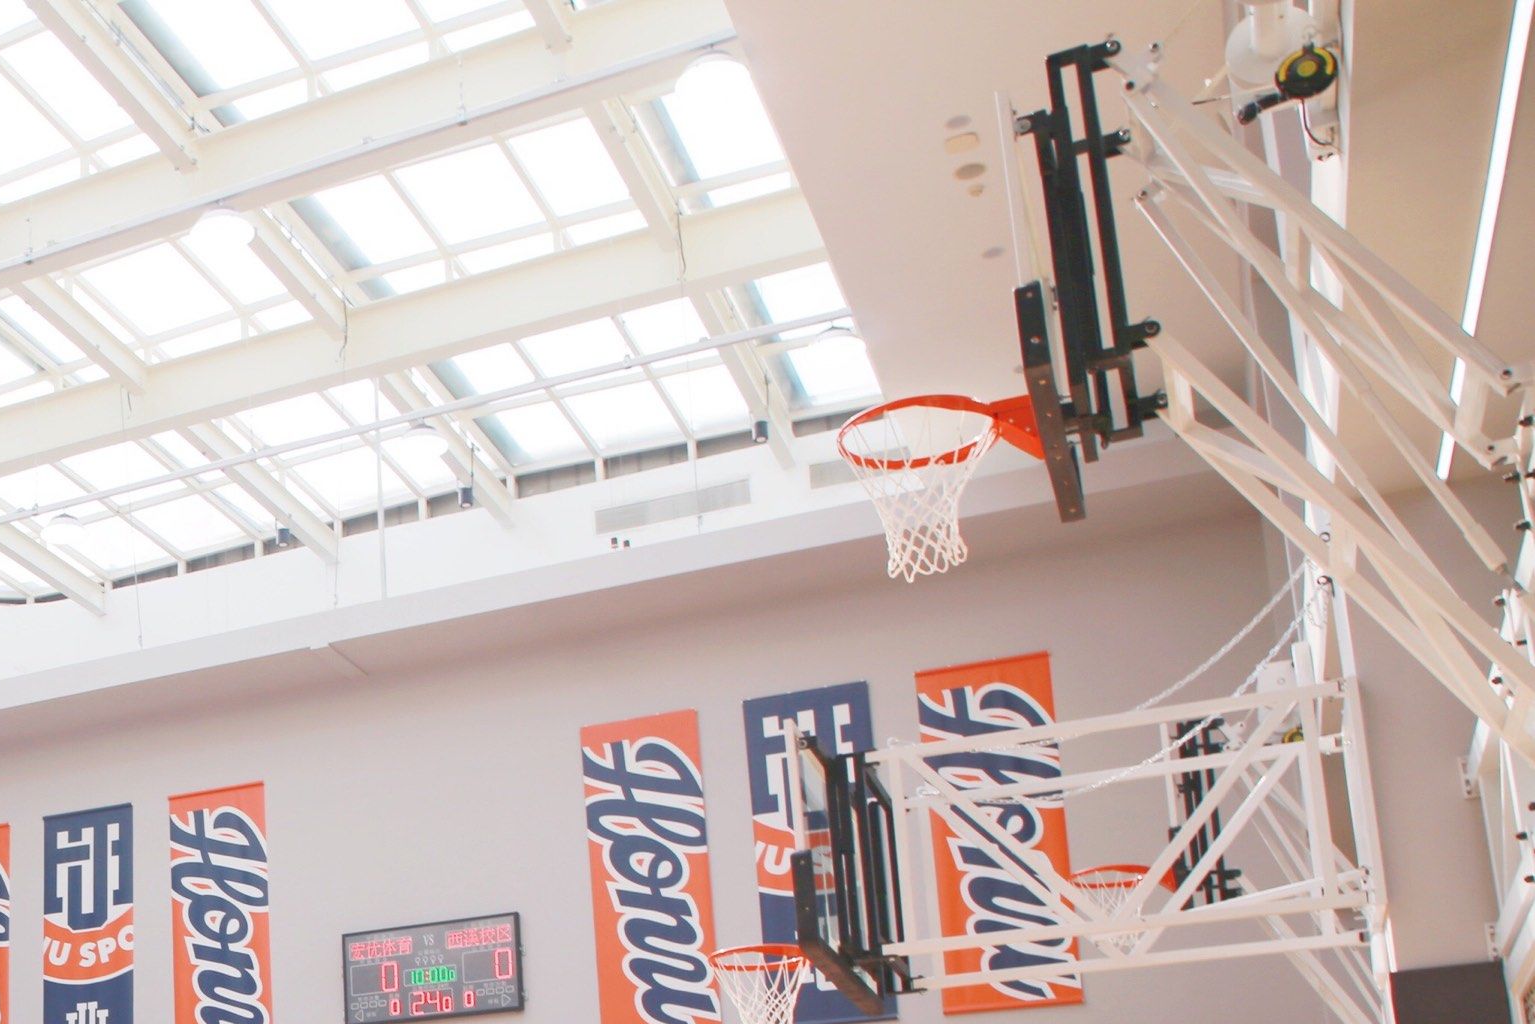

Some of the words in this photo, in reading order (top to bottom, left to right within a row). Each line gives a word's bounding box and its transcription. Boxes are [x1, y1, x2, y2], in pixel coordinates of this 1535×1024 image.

[494, 948, 512, 979] 0
[381, 962, 399, 992] 0
[390, 999, 401, 1016] 0
[464, 990, 475, 1007] 0
